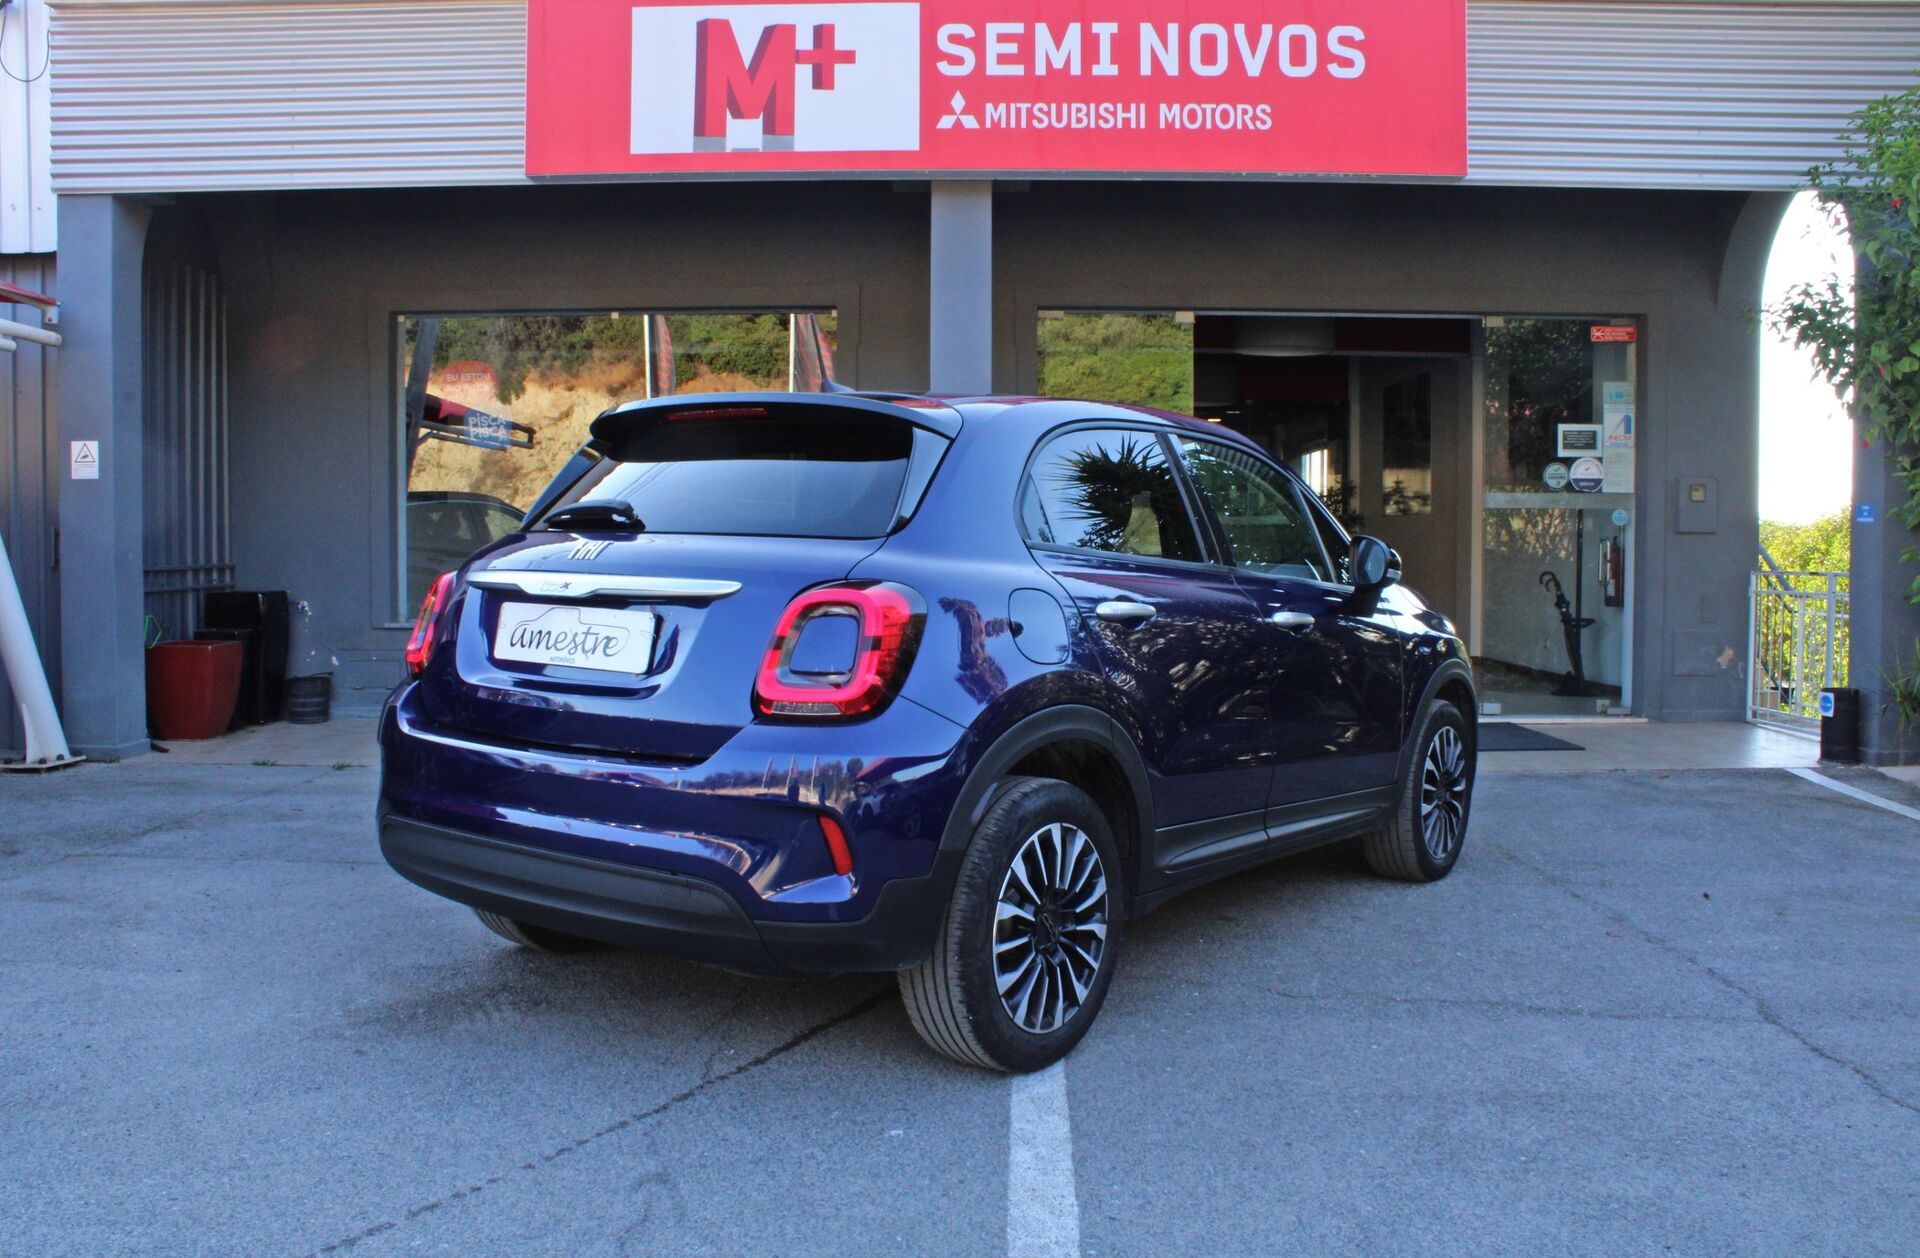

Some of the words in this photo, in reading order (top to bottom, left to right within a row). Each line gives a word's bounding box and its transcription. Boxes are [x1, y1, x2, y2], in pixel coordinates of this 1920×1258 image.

[936, 22, 1119, 77] SEMI
[1139, 22, 1366, 79] NOVOS
[985, 102, 1146, 129] MITSUBISHI
[1159, 103, 1273, 131] MOTORS
[510, 623, 620, 658] amestre
